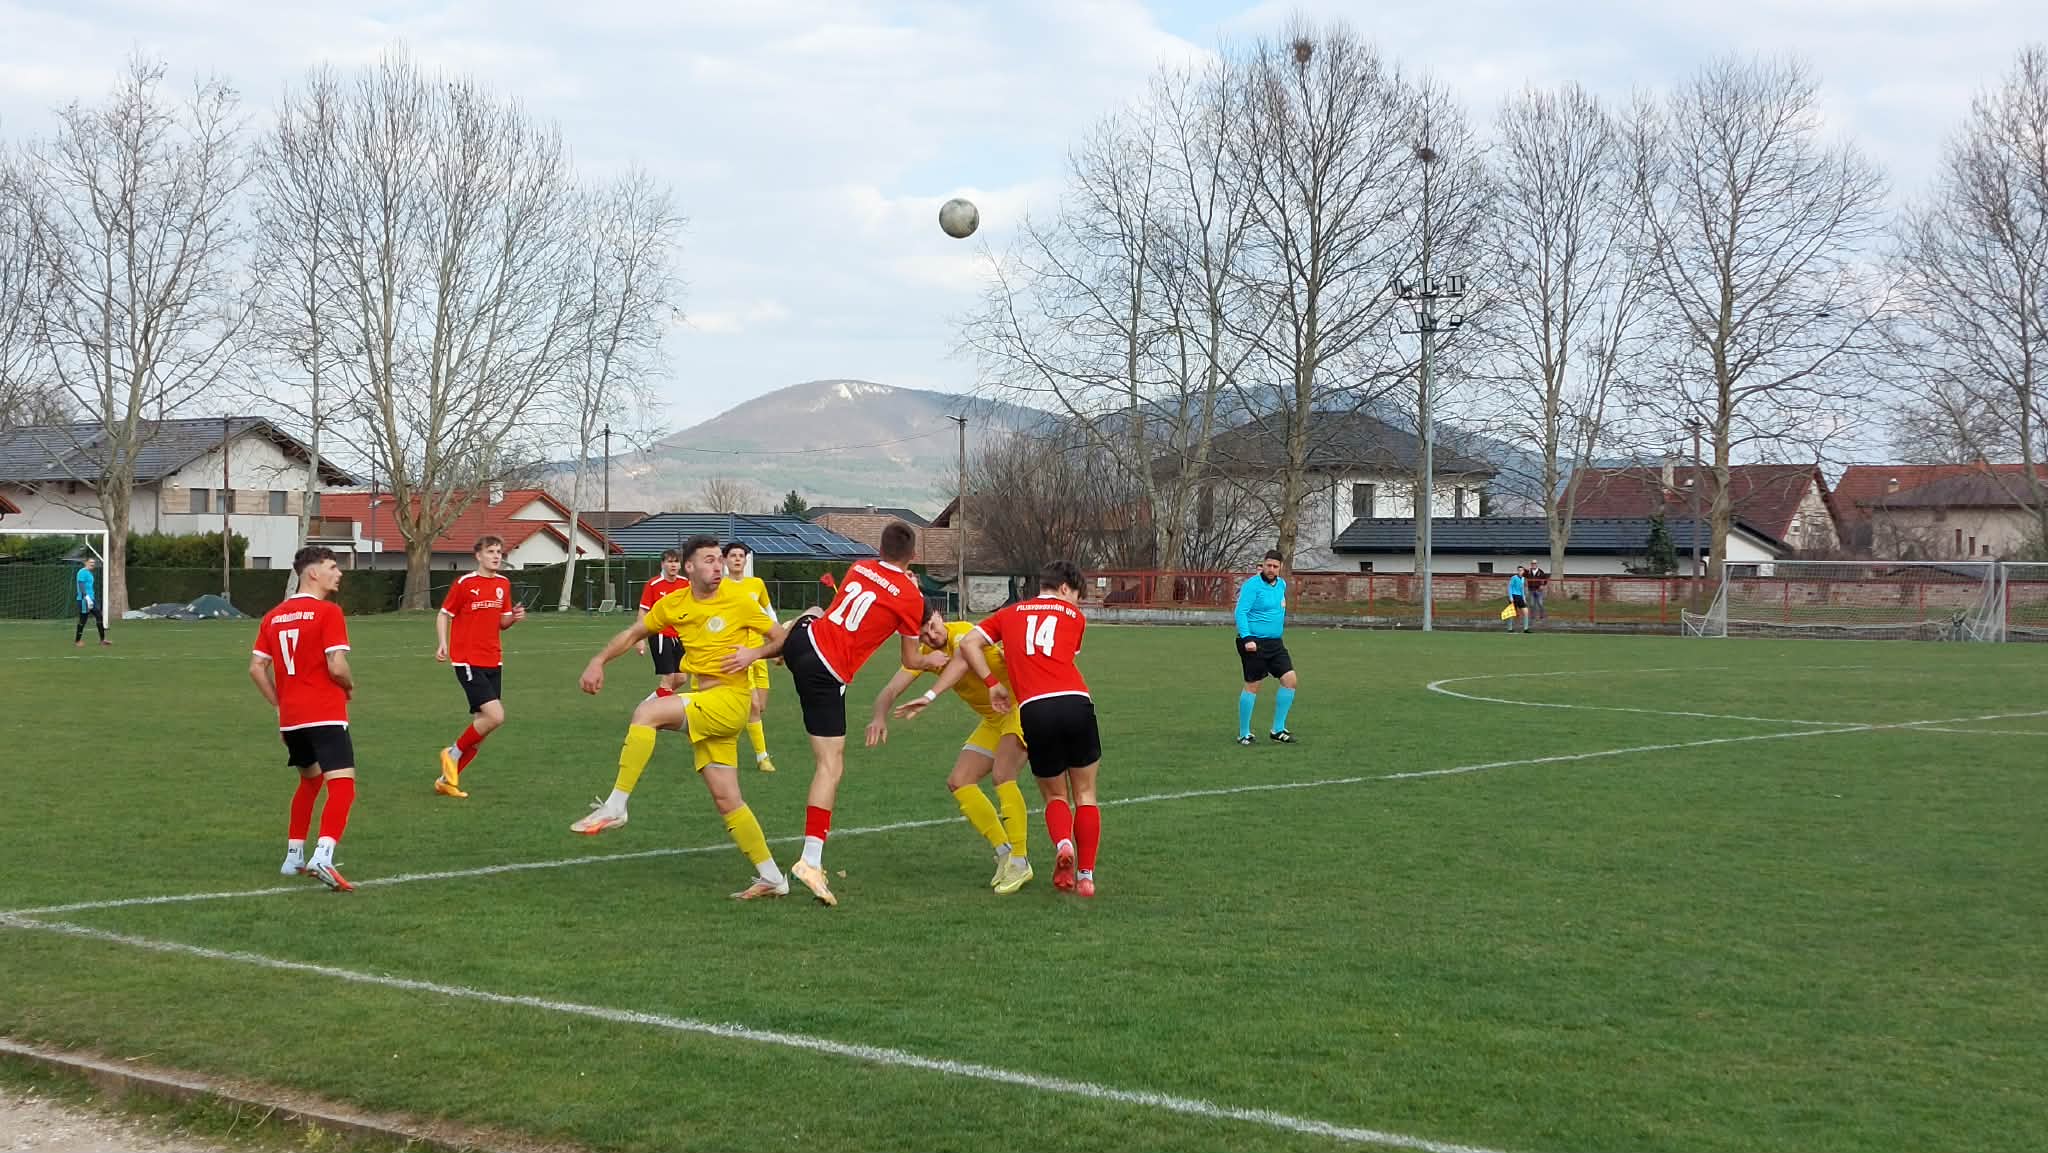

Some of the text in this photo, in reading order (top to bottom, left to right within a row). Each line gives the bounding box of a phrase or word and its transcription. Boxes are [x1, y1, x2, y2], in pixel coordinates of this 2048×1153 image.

[828, 581, 877, 632] 20
[279, 628, 299, 675] 17
[1026, 615, 1058, 657] 14
